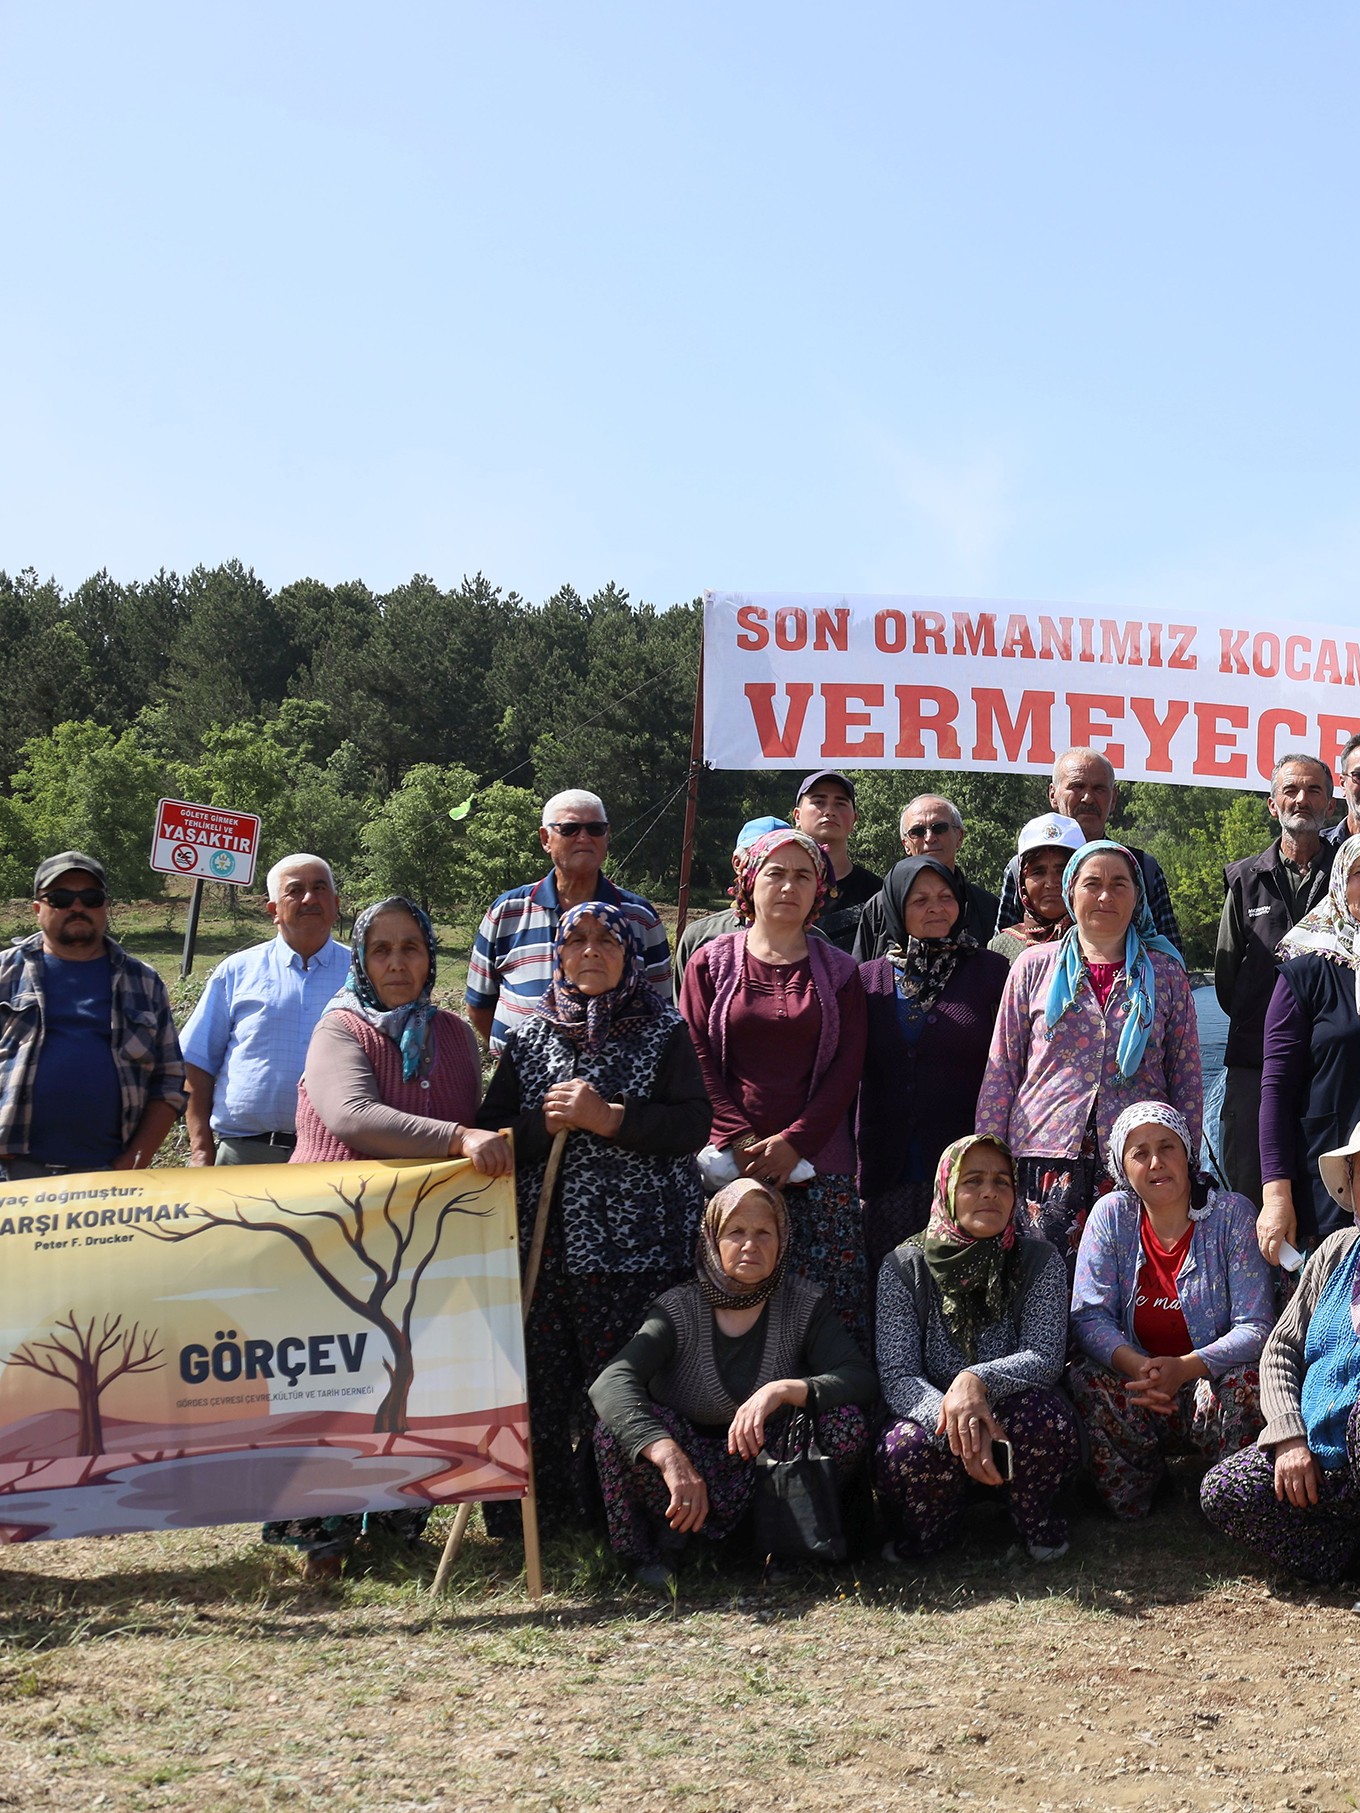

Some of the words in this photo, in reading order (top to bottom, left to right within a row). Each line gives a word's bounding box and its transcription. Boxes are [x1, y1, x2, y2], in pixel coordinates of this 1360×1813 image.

[737, 606, 849, 652] SON
[875, 608, 1197, 670] ORMANIMIZ
[180, 809, 209, 820] GÖLETE
[210, 813, 239, 826] GİRMEK
[184, 819, 222, 832] TEHLİKELİ
[223, 826, 234, 834] VE
[163, 823, 251, 853] YASAKTIR
[35, 1186, 144, 1204] doğmuştur;
[66, 1202, 191, 1230] KORUMAK
[34, 1241, 68, 1251] Peter
[71, 1238, 82, 1247] F.
[85, 1233, 135, 1246] Drucker
[179, 1330, 368, 1387] GÖRÇEV
[176, 1398, 208, 1408] GÖRDES
[305, 1390, 315, 1399] VE
[317, 1388, 340, 1398] TARİH
